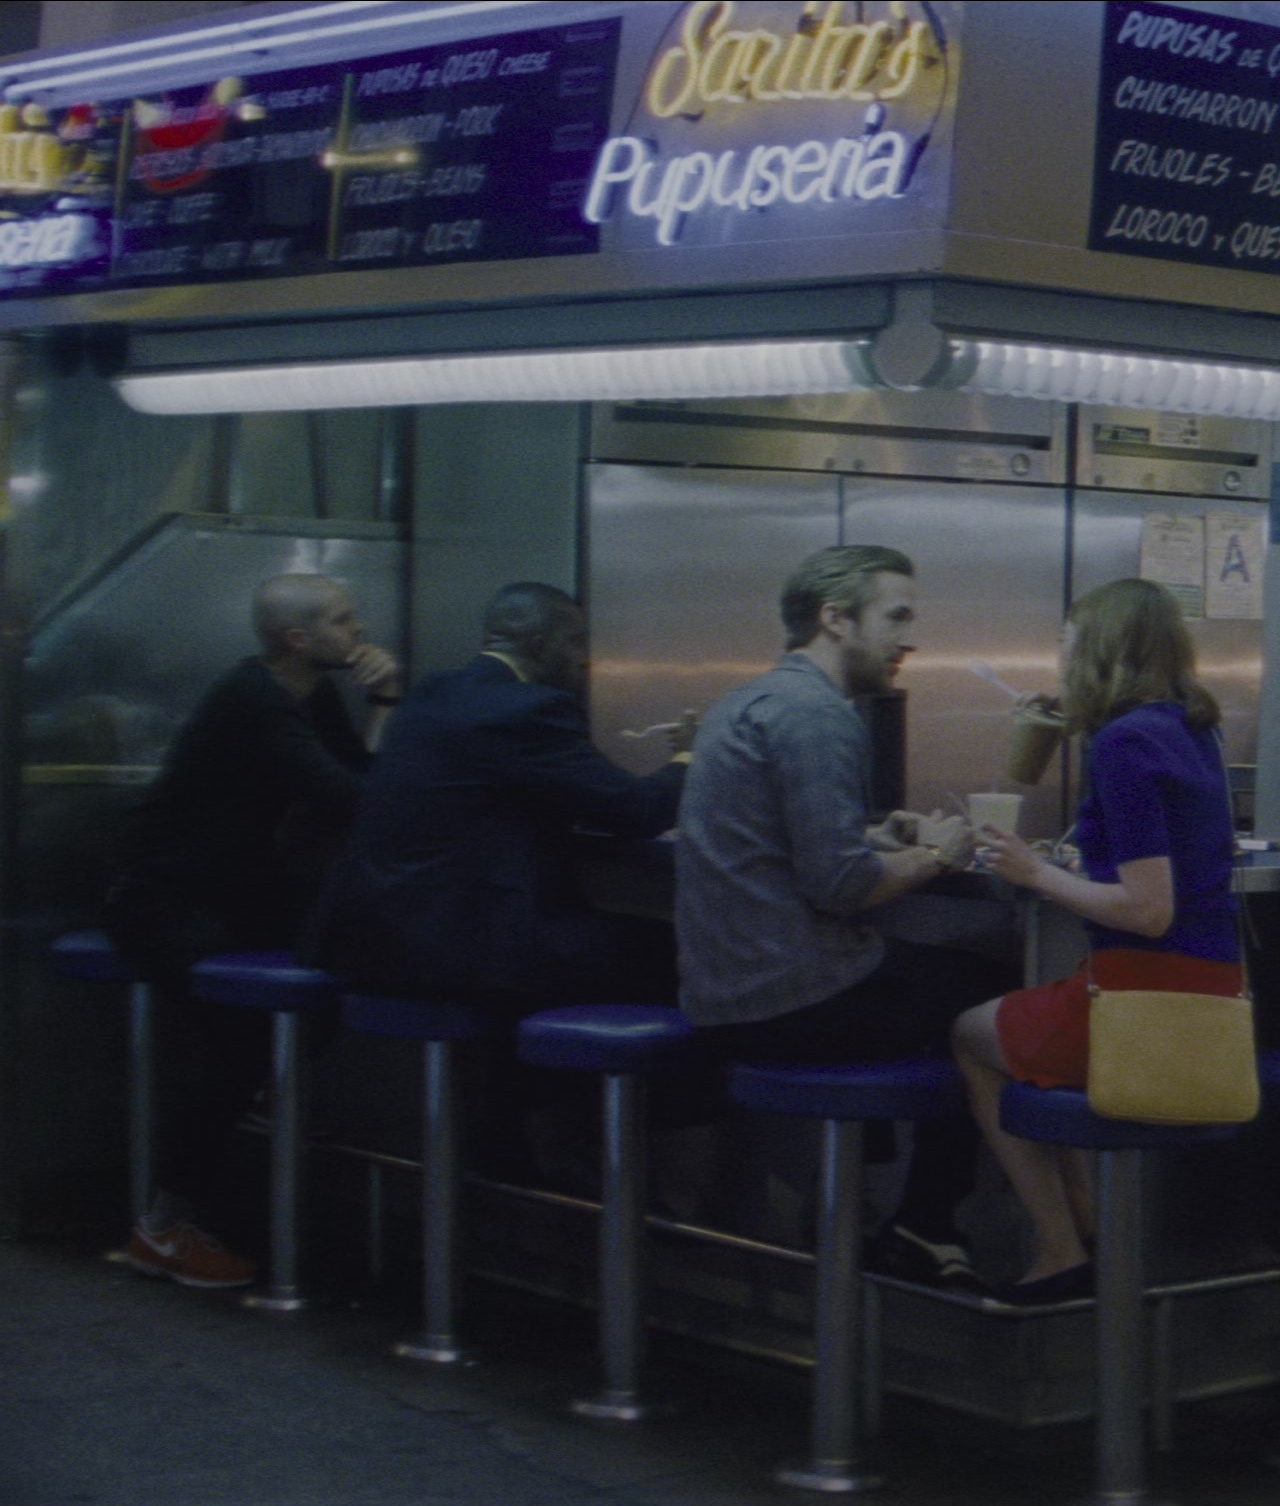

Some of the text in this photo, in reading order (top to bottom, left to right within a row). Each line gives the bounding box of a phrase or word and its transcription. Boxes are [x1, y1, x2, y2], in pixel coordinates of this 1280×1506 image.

[1117, 10, 1240, 65] PUPUSAS
[1237, 49, 1263, 68] DE
[440, 48, 500, 87] QUESO
[1113, 75, 1280, 135] CHICHARRON
[1109, 139, 1234, 187] FRIJOLES
[1105, 204, 1209, 247] LOROCO
[1219, 533, 1250, 583] A
